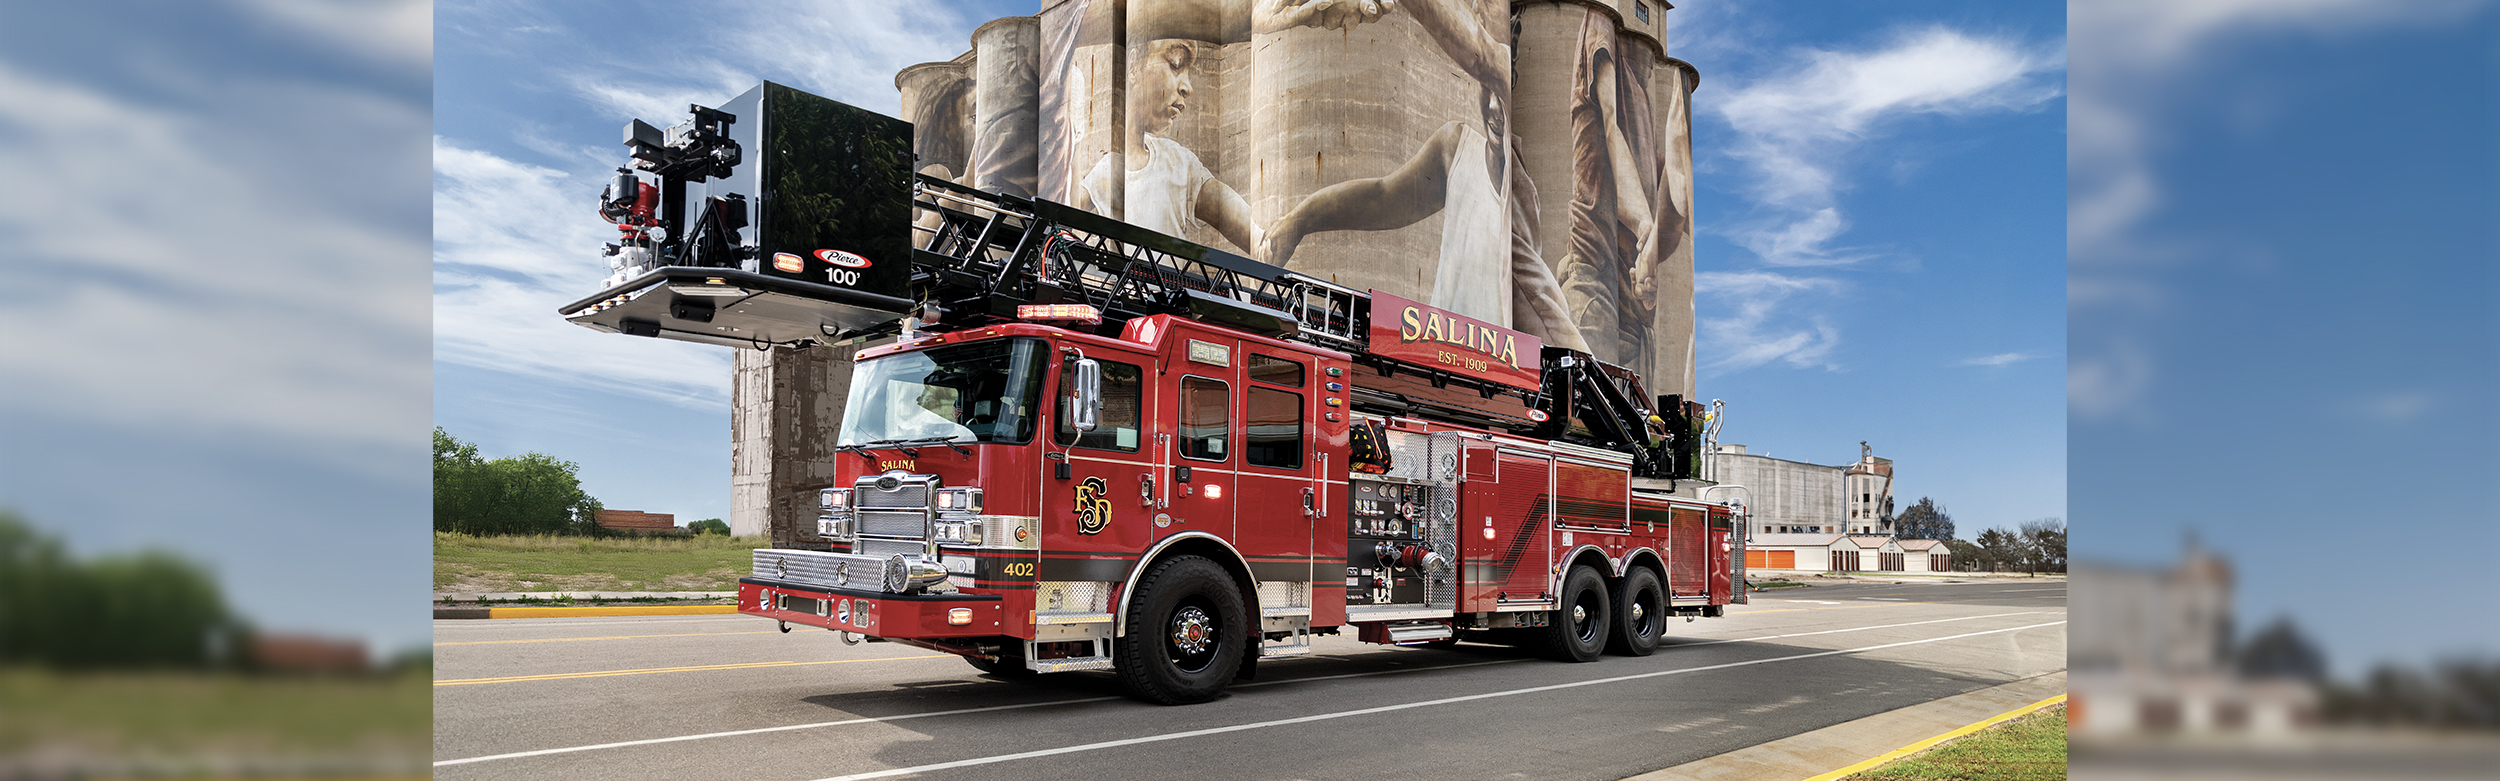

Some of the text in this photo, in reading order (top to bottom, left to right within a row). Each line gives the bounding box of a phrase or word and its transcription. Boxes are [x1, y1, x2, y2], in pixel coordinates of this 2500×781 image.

[827, 251, 859, 265] Pierce
[1400, 305, 1519, 372] SALINA
[1438, 350, 1488, 373] EST. 1909
[881, 459, 916, 473] SALINA
[1003, 562, 1034, 577] 402
